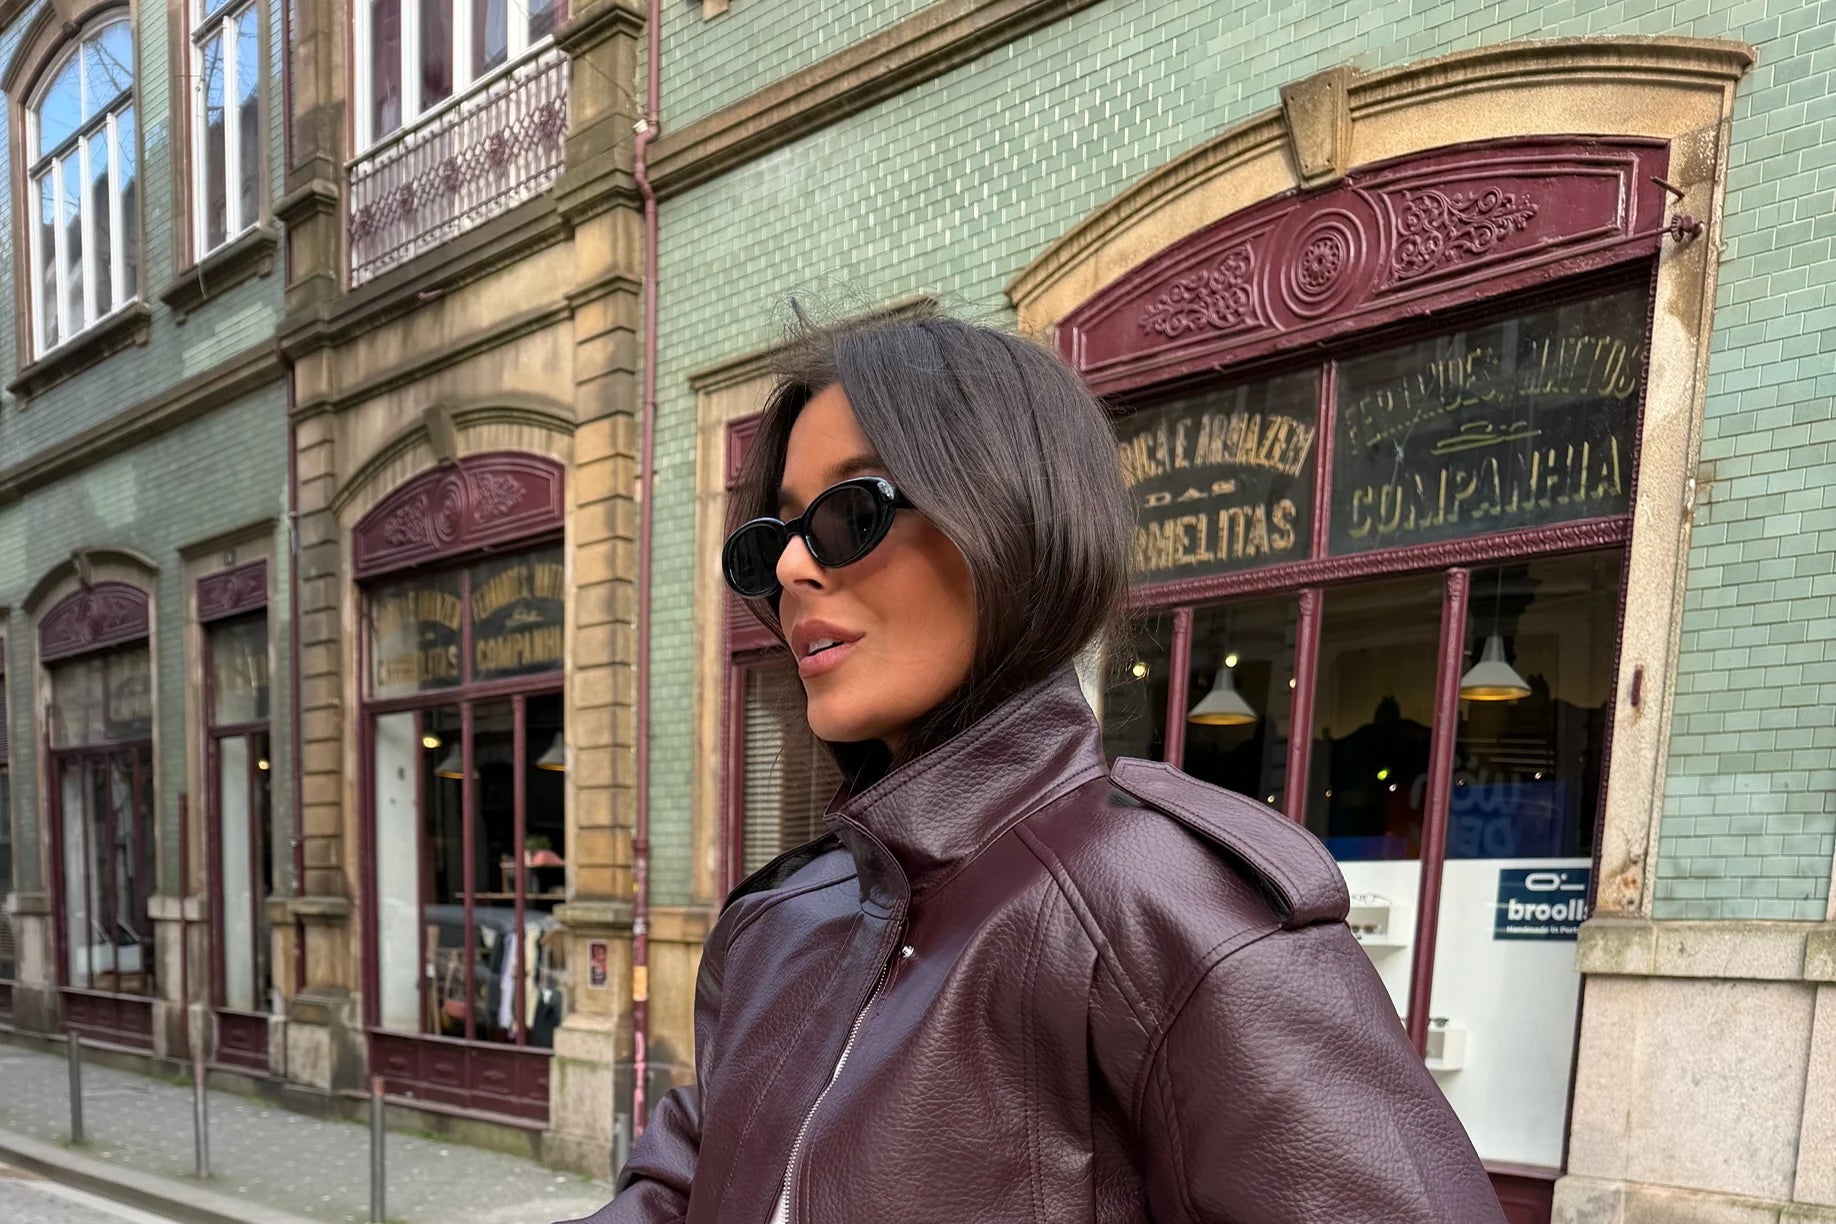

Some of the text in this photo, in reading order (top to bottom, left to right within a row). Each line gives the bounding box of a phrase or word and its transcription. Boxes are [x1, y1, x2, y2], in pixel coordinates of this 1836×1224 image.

[1143, 479, 1237, 509] DAS
[1349, 433, 1623, 539] COMPANHIA
[1131, 498, 1298, 573] RMELITAS
